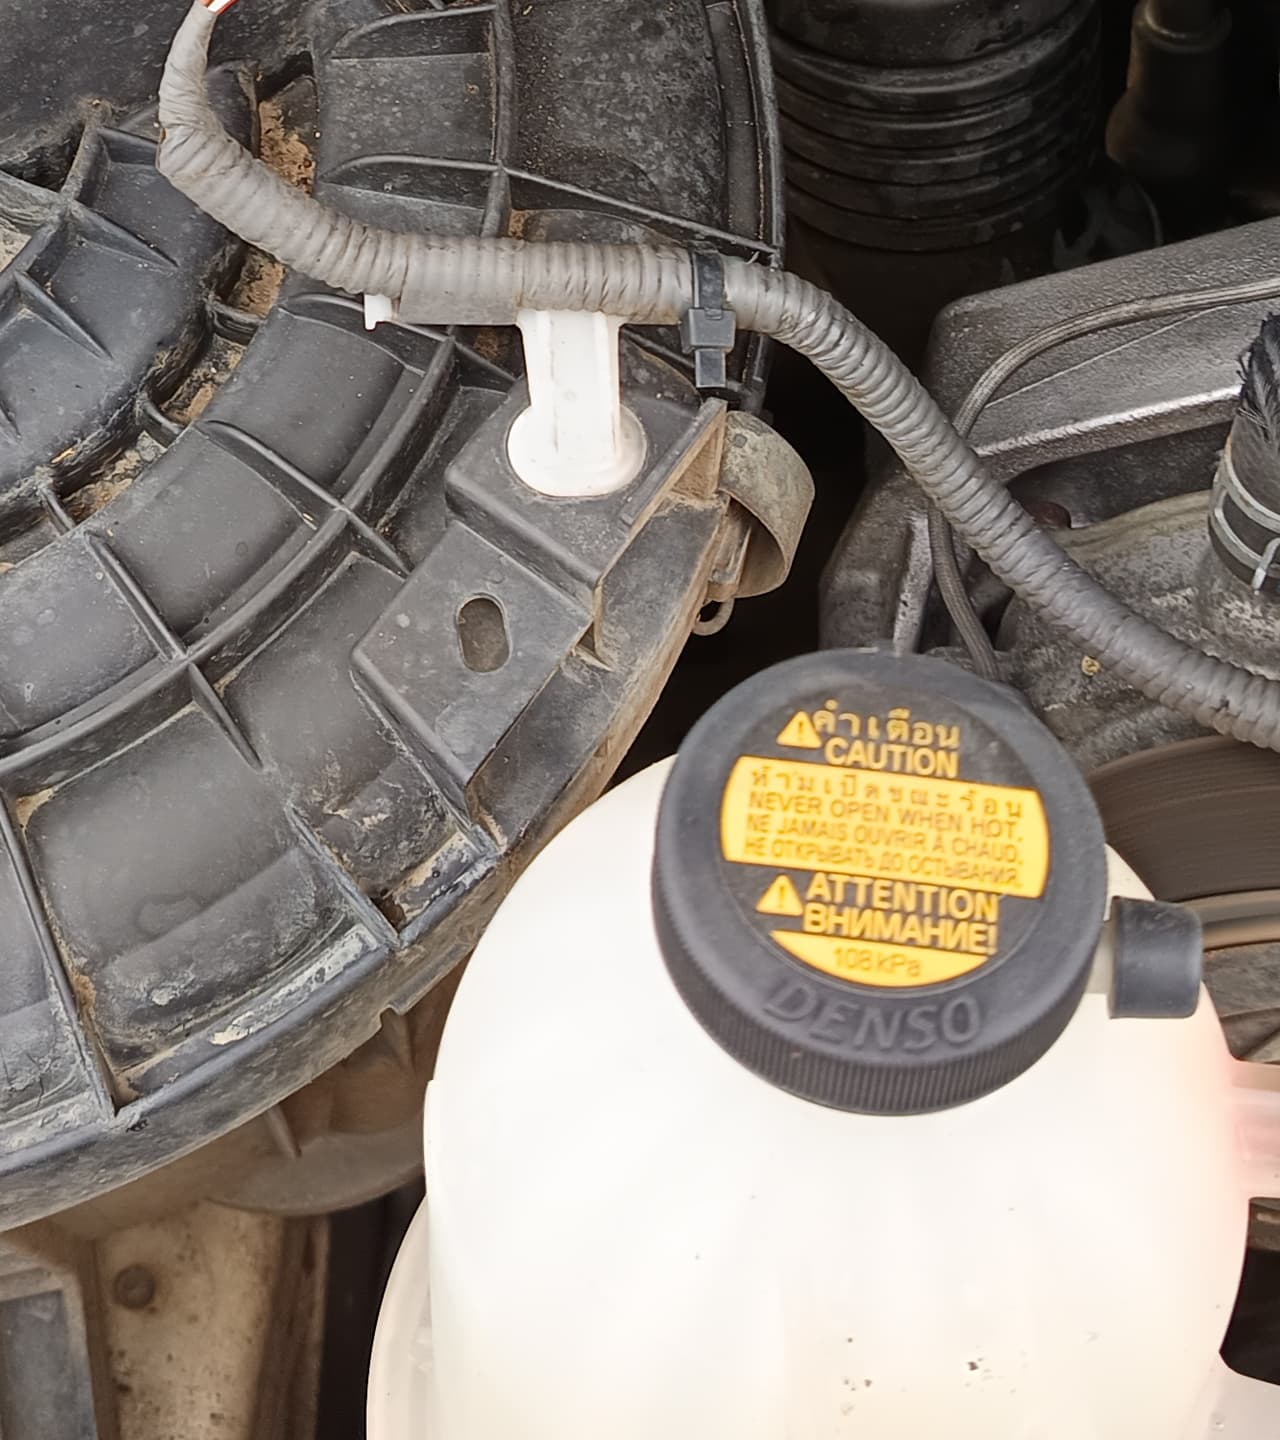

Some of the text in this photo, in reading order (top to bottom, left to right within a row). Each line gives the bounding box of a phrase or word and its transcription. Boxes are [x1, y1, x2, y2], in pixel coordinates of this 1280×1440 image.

[824, 738, 959, 779] CAUTION
[747, 814, 771, 834] NE
[776, 816, 848, 843] JAMAIS
[854, 823, 927, 850] OUVRIR
[748, 790, 1025, 842] NEVER OPEN WHEN HOT.
[805, 872, 999, 923] ATTENTION
[804, 903, 998, 956] ВНИМАНИЕ!
[762, 981, 980, 1050] DENSO
